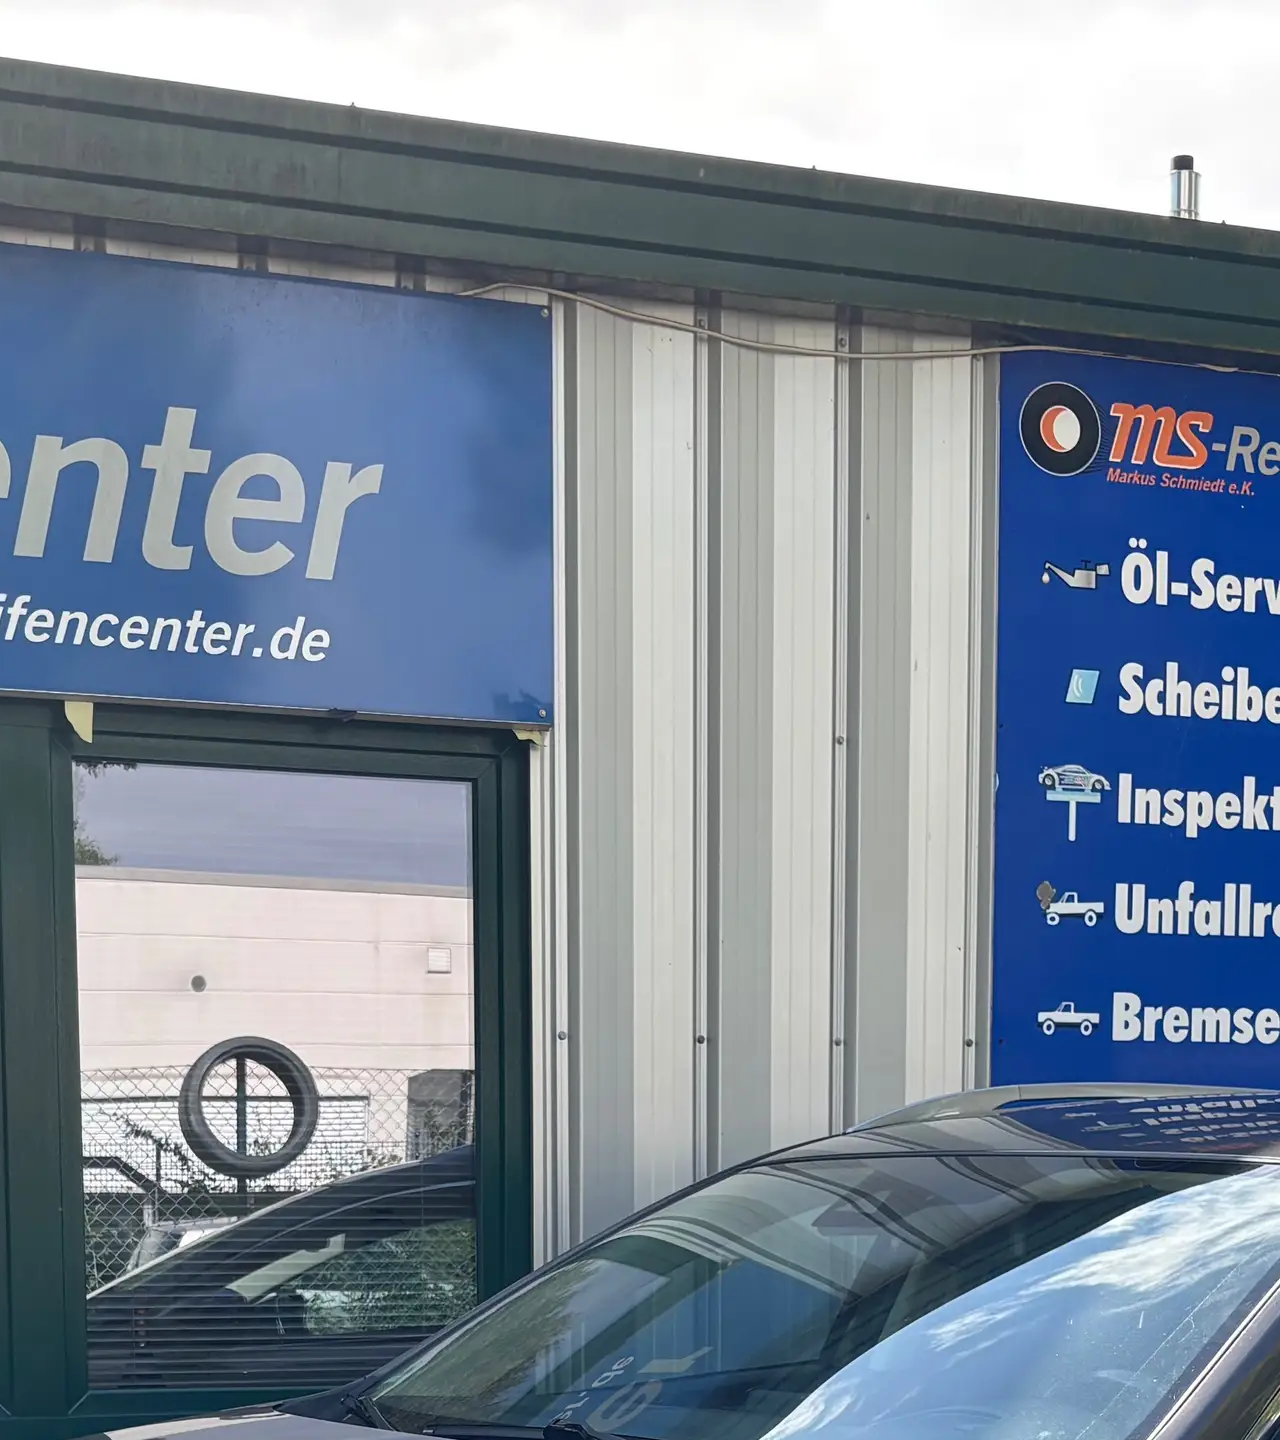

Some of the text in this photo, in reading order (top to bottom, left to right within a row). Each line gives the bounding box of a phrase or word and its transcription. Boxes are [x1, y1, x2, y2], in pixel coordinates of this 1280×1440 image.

[1107, 467, 1256, 497] Markus Schmiedt e.K.
